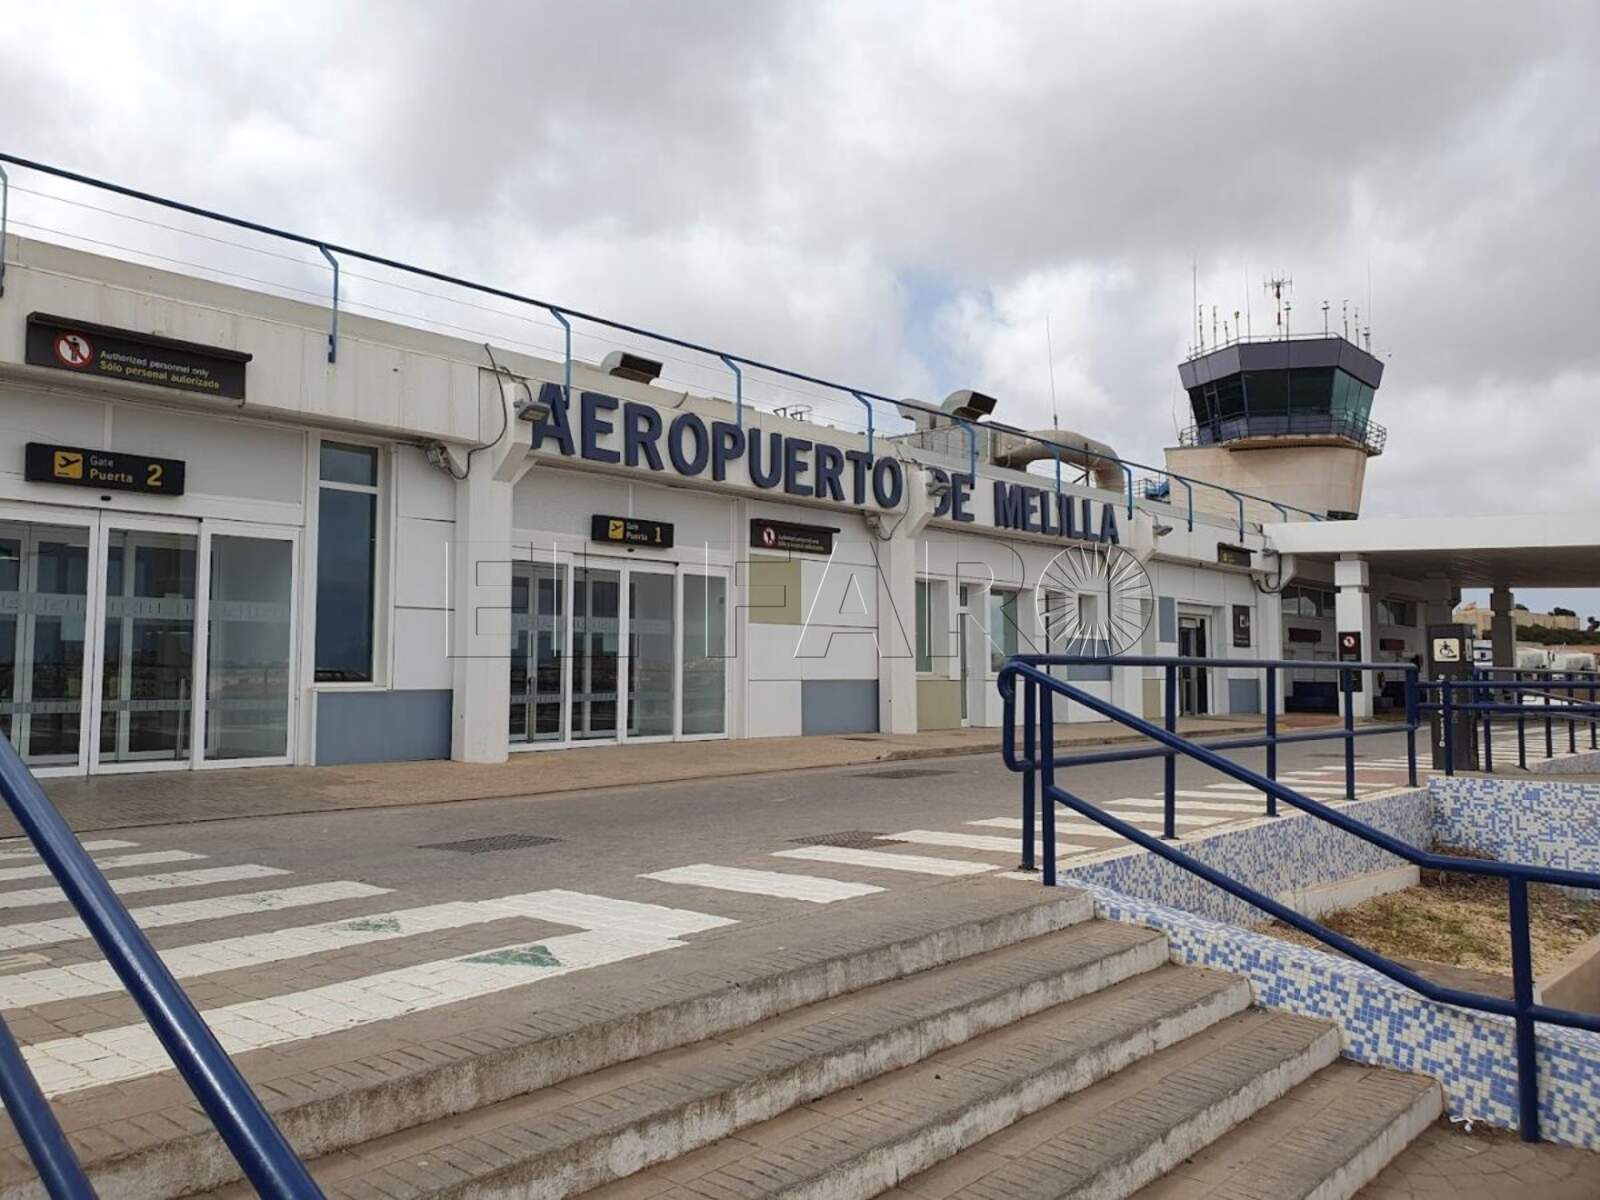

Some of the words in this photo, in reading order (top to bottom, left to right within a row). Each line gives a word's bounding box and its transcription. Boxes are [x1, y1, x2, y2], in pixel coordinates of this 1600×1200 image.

[100, 350, 148, 367] Authorized
[149, 360, 190, 375] personnel
[191, 366, 209, 378] only
[125, 366, 168, 381] personal
[170, 374, 220, 389] autorizado
[89, 454, 114, 468] Gate
[531, 382, 902, 509] AEROPUERTO
[993, 480, 1120, 545] MELILLA
[89, 468, 134, 484] Puerta
[146, 463, 163, 487] 2
[655, 526, 662, 543] 1
